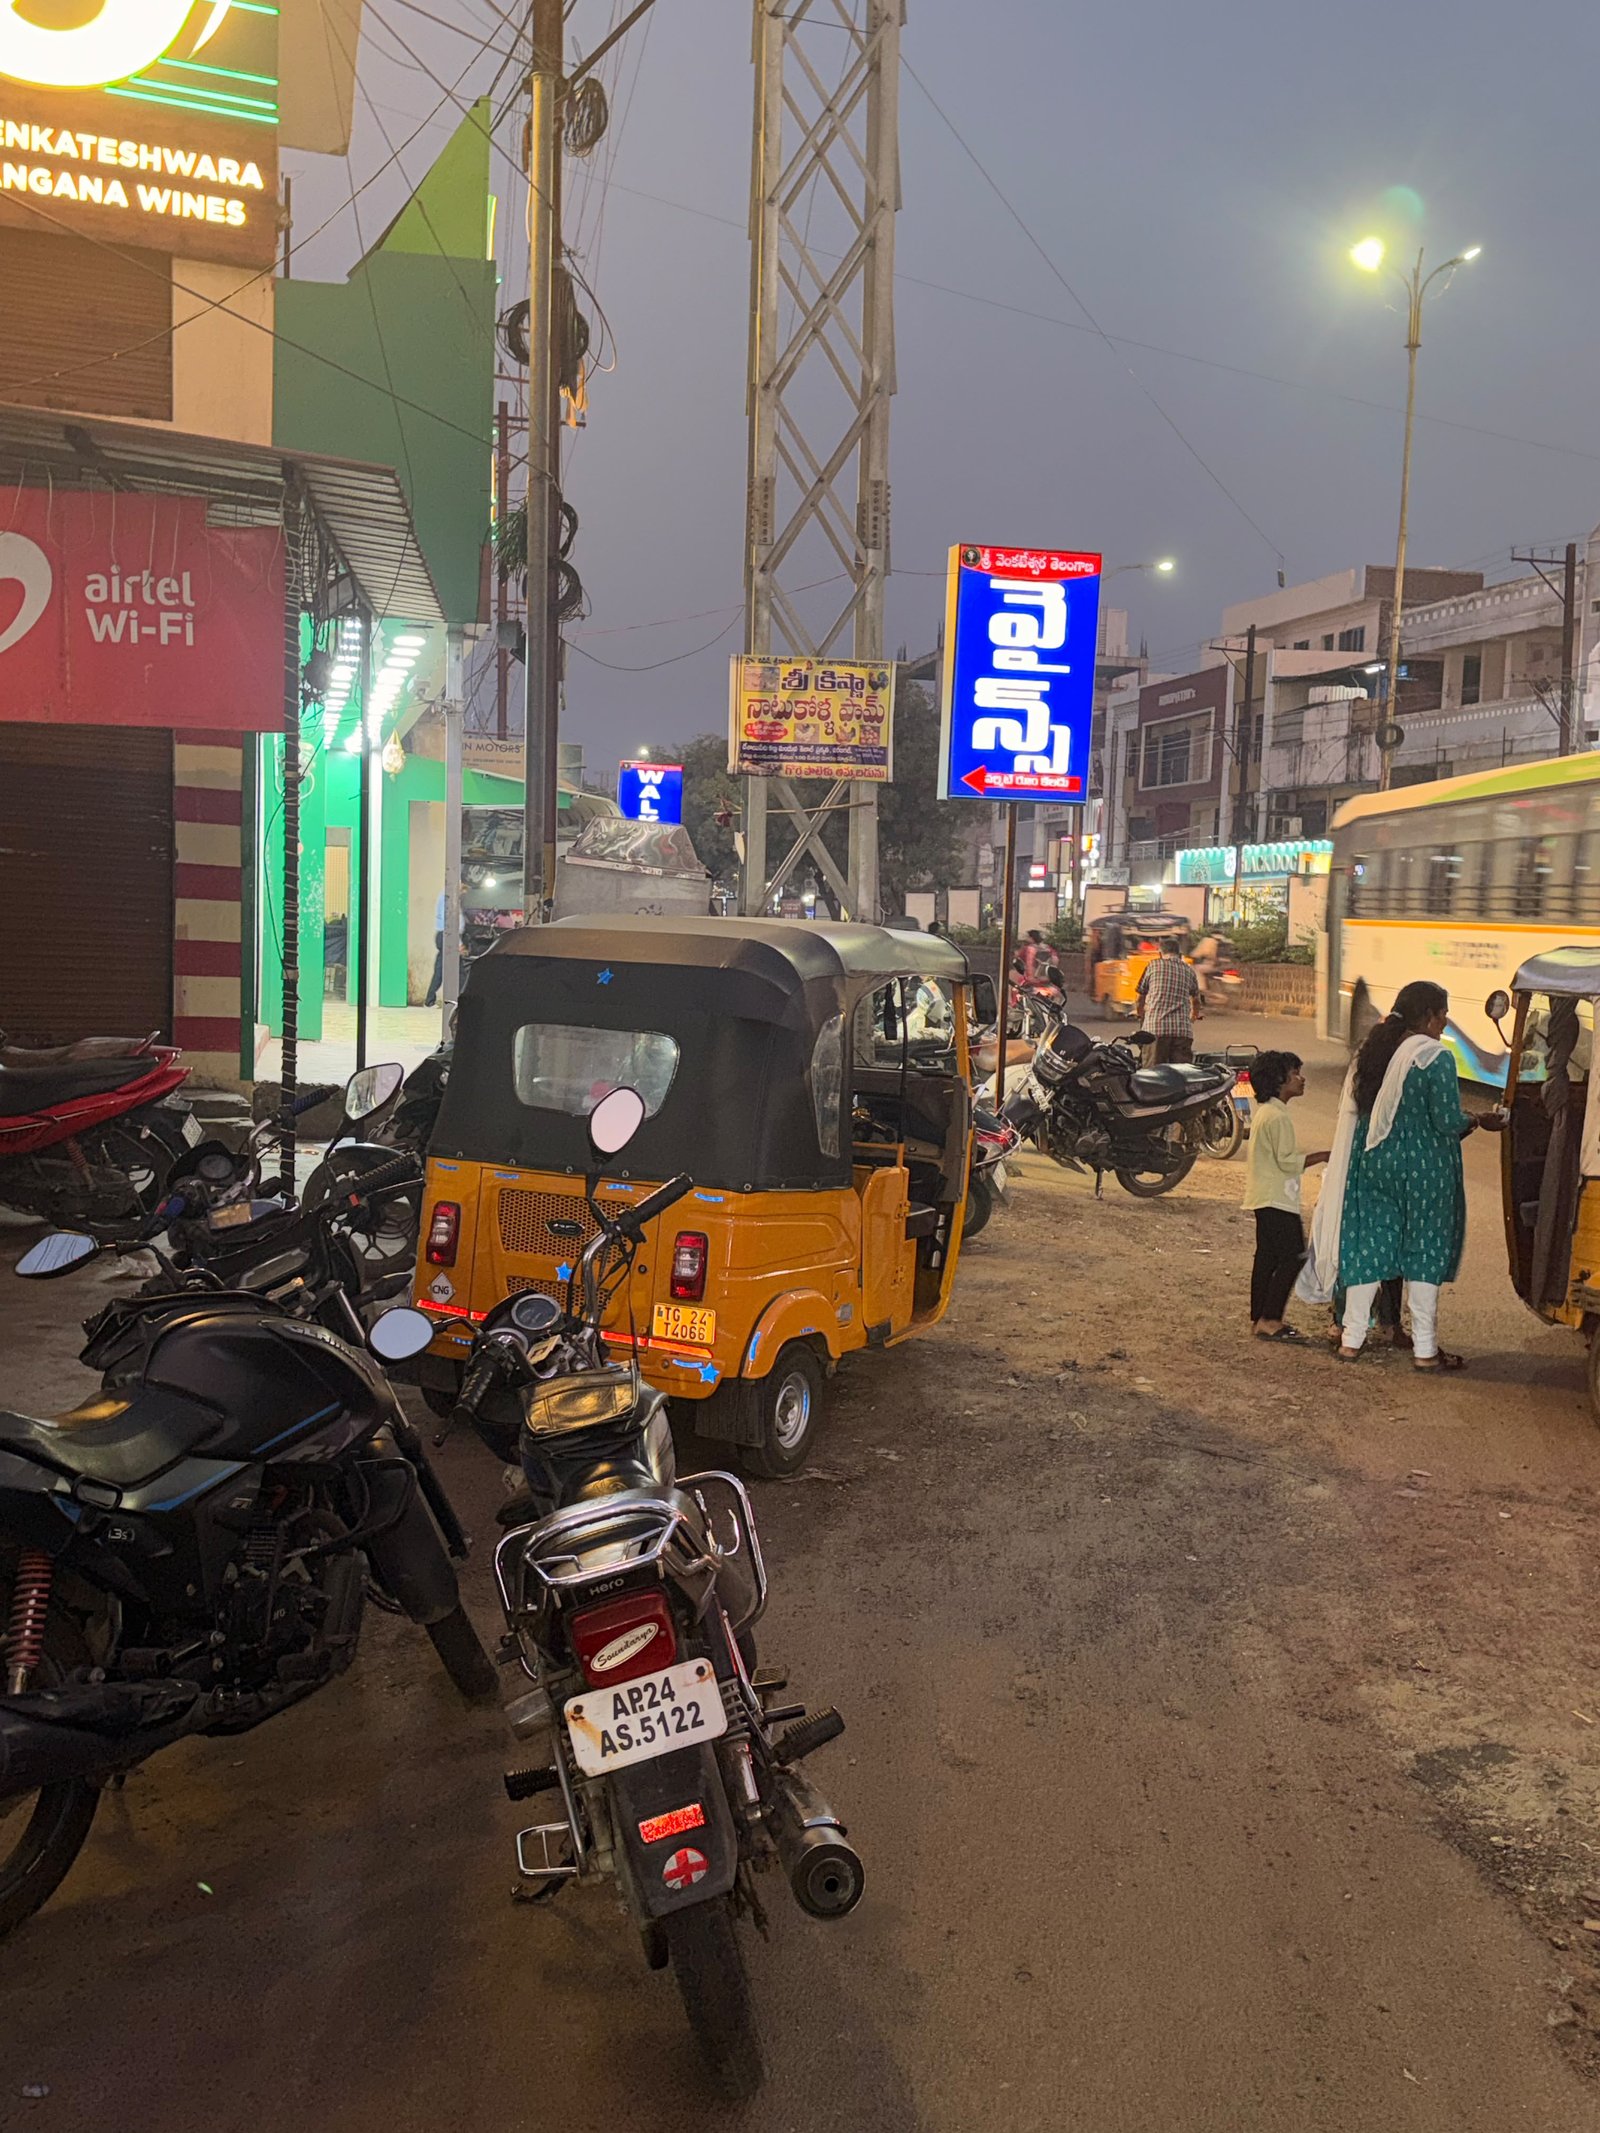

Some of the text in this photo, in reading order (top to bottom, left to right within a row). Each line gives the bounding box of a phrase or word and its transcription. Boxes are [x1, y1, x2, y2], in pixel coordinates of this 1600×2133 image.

[0, 119, 264, 190] NKATESHWARA
[0, 162, 247, 226] NGANA WINES
[980, 549, 992, 569] శ్రీ
[1050, 557, 1095, 573] తెలంగాణ
[84, 563, 195, 607] airtel
[85, 607, 195, 647] Wi-Fi
[781, 669, 809, 691] శ్రీ
[476, 743, 521, 754] MOTORS
[1271, 852, 1297, 873] DOG
[432, 1284, 449, 1295] CNG
[664, 1306, 707, 1326] TG 24
[663, 1322, 706, 1341] T4066
[597, 1626, 654, 1668] Soundarya
[600, 1701, 705, 1758] AS.5122
